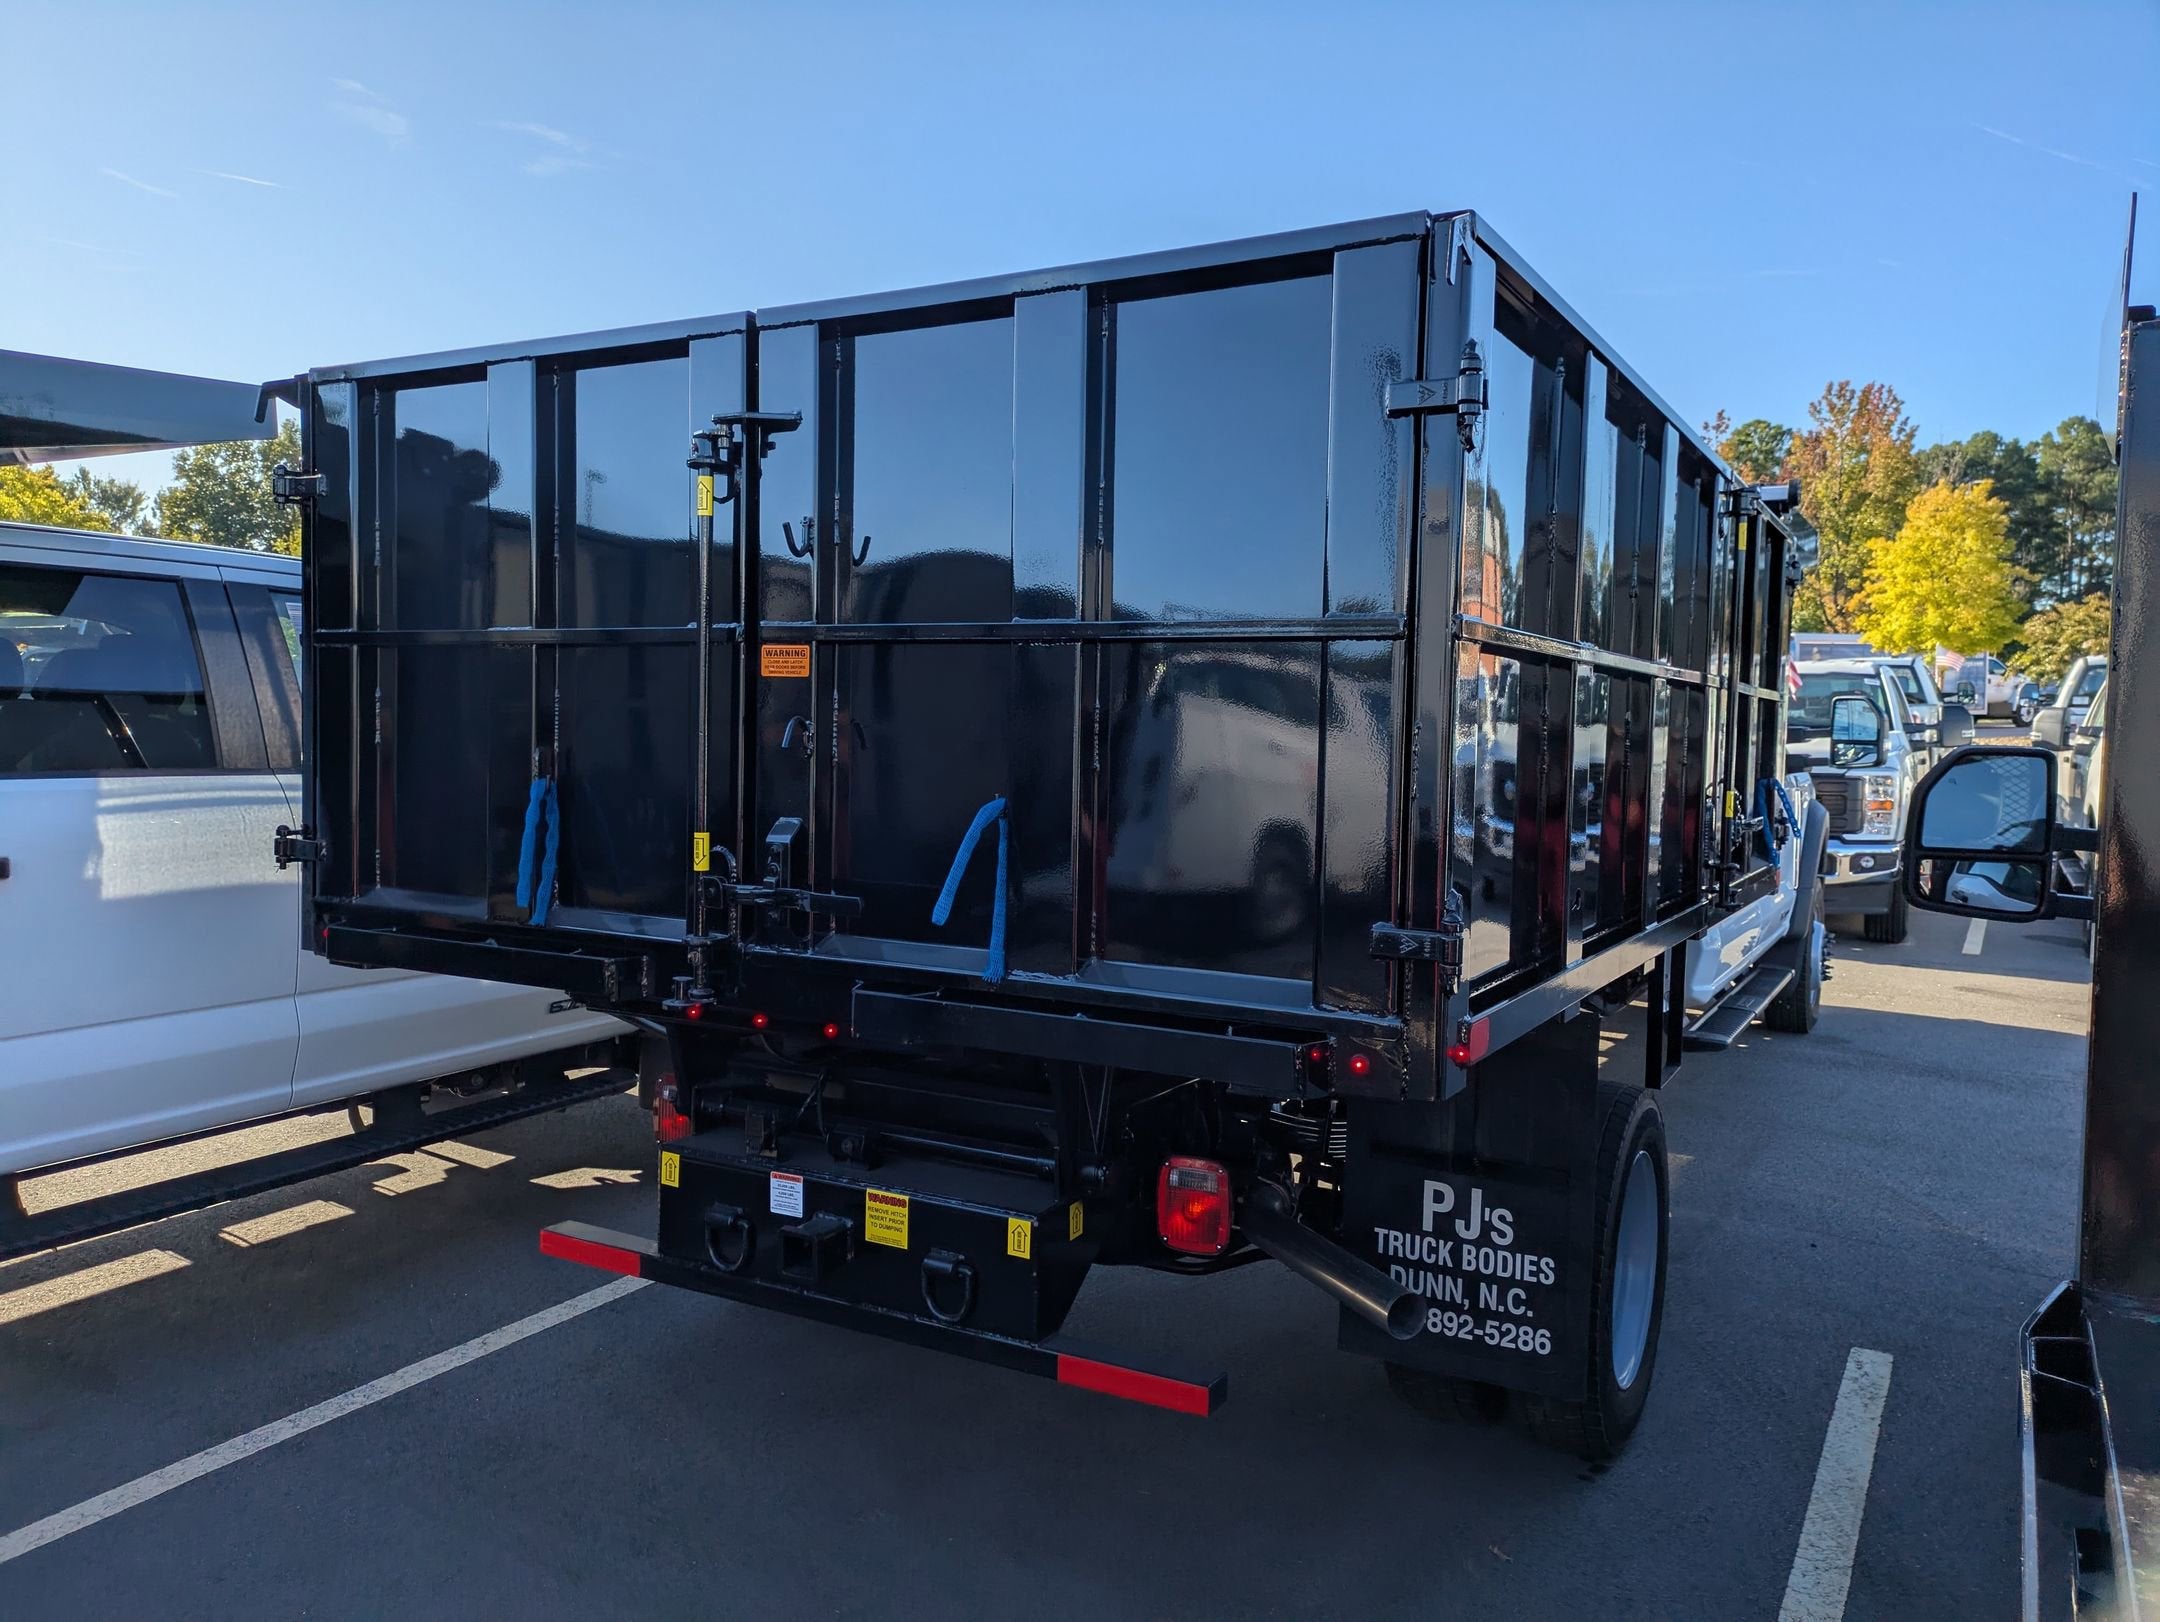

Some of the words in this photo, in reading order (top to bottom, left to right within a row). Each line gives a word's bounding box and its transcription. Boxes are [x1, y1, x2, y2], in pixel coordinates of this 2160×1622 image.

[765, 649, 806, 657] WARNING
[867, 1191, 907, 1209] WARNING
[867, 1205, 890, 1215] REMOVE
[890, 1210, 907, 1219] HITCH
[868, 1214, 888, 1222] INSERT
[888, 1217, 905, 1226] PRIOR
[878, 1223, 903, 1233] DUMPING
[1374, 1227, 1454, 1268] TRUCK
[1462, 1243, 1556, 1285] BODIES
[1479, 1282, 1534, 1317] N.C.
[1424, 1307, 1552, 1356] 892-5286
